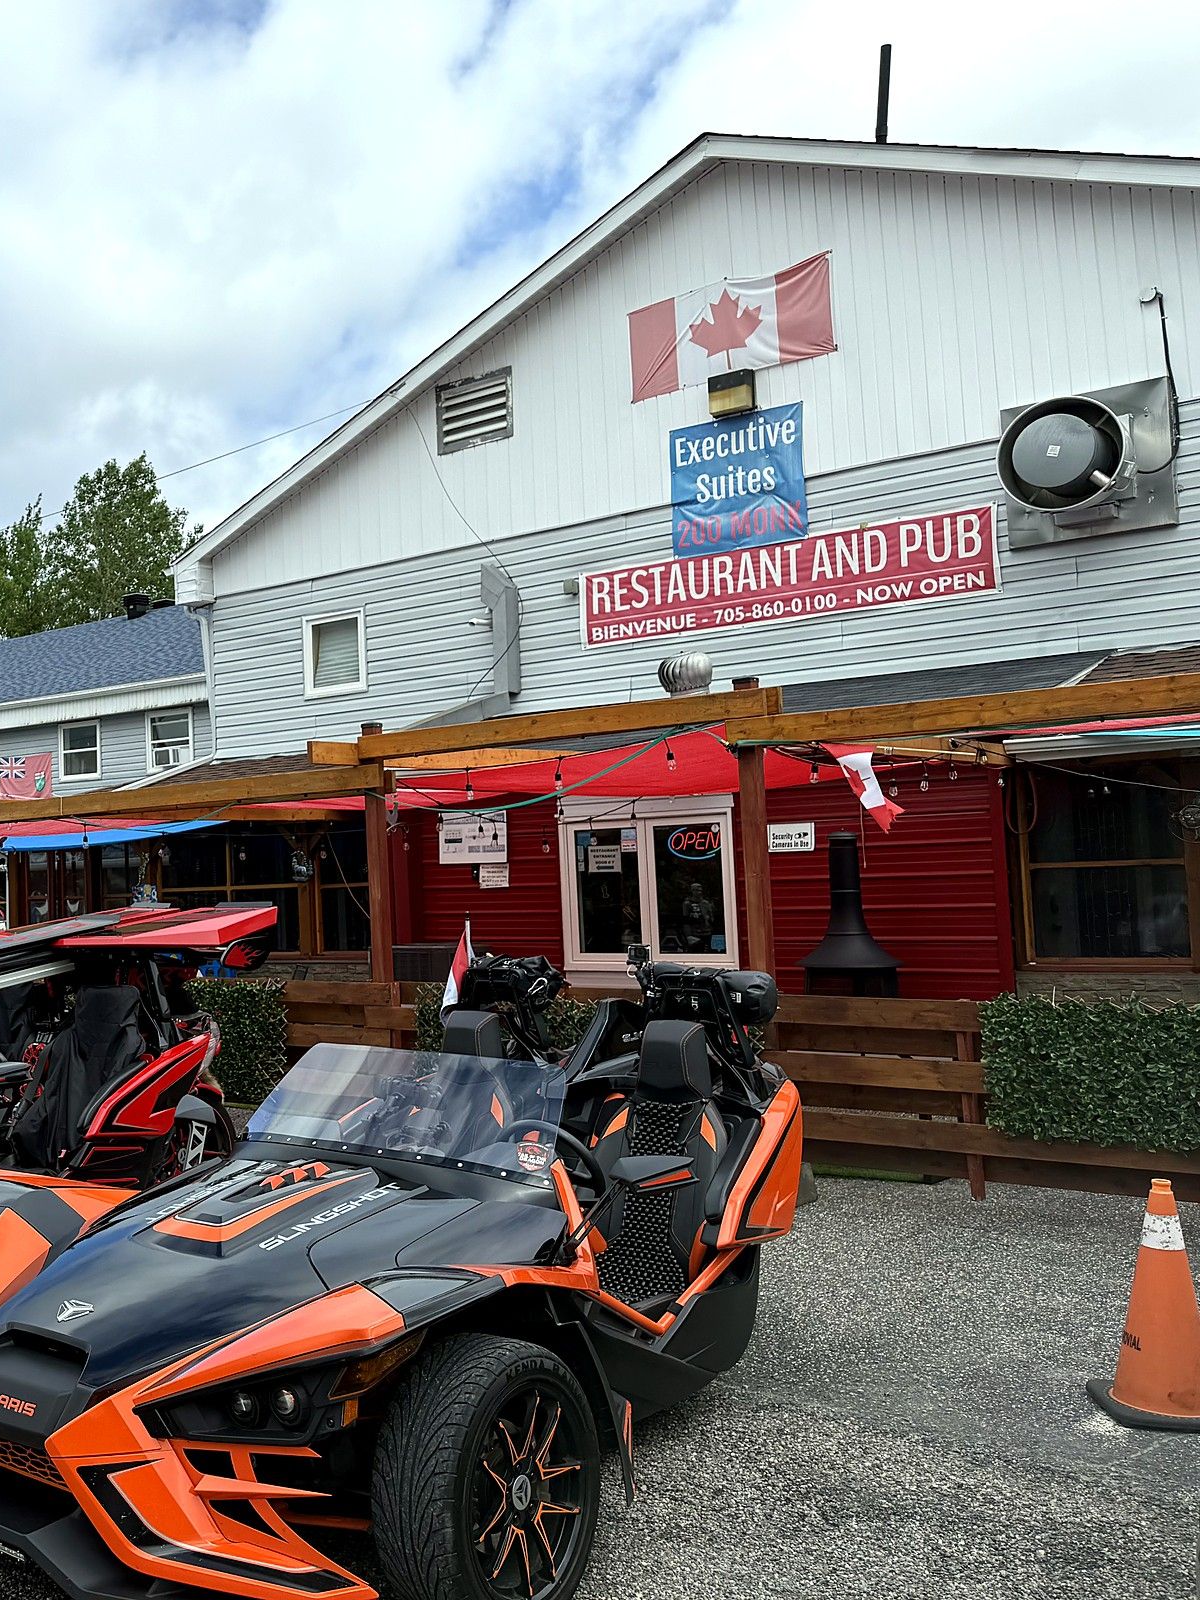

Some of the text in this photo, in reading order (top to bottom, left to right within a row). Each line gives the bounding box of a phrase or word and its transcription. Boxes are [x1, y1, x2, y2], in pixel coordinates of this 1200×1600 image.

[674, 416, 796, 467] Executive
[696, 465, 776, 503] Suites
[677, 515, 722, 549] 200
[591, 513, 982, 615] RESTAURANT AND PUB
[591, 613, 697, 642] BIENVENUE
[713, 592, 837, 625] 705-860-0100
[856, 580, 915, 605] NOW
[919, 570, 986, 595] OPEN
[671, 831, 720, 850] OPEN
[771, 833, 794, 841] Security
[258, 1180, 402, 1251] SLINGSHOT
[505, 1359, 545, 1383] KENDA
